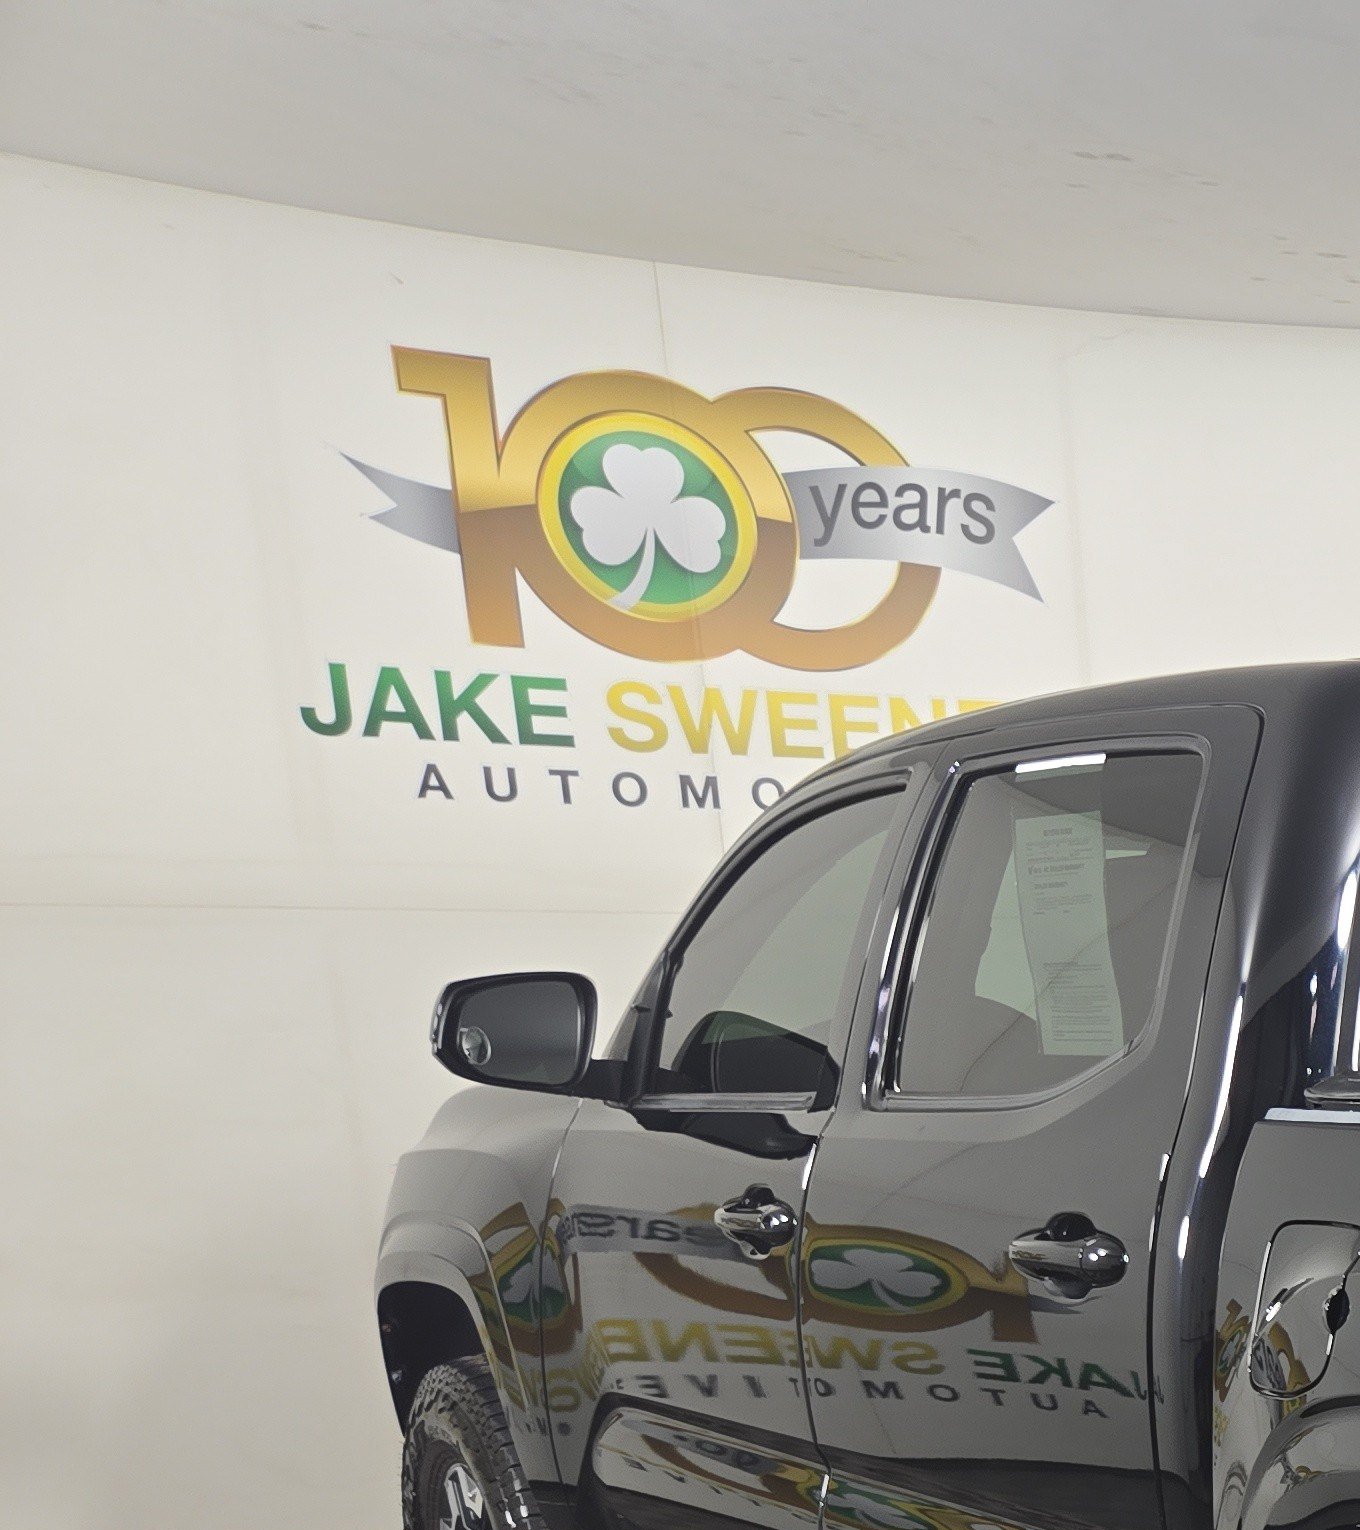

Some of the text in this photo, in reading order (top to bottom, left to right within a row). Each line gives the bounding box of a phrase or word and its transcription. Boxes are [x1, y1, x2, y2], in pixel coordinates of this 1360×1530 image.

[808, 481, 996, 546] years
[300, 662, 1003, 759] JAKE SWEEN
